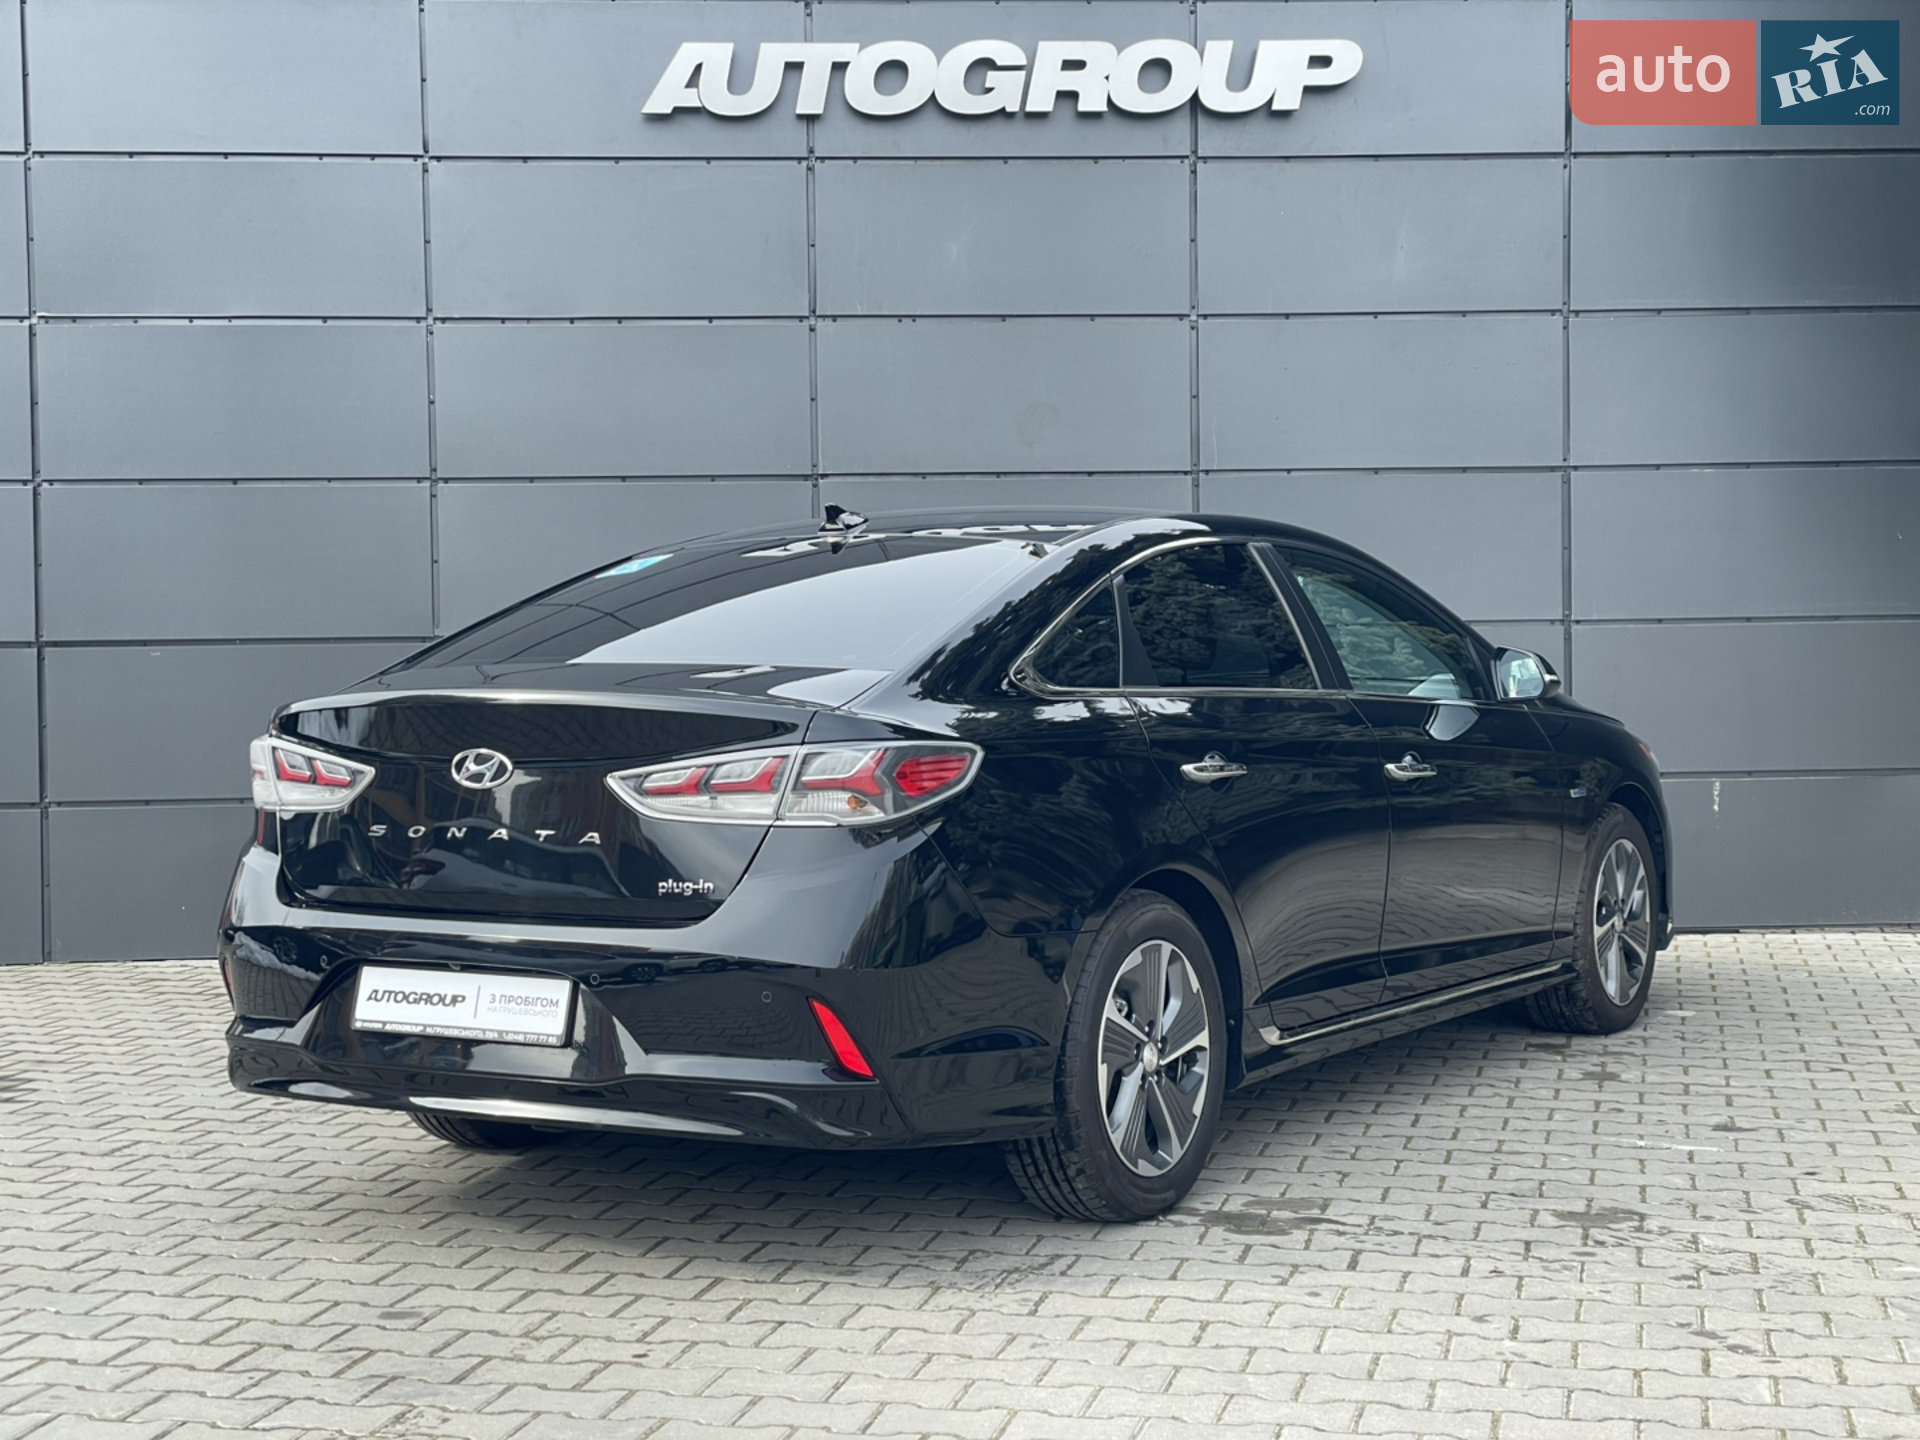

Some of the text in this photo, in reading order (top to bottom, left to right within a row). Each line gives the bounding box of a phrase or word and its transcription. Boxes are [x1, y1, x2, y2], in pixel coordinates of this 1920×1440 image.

[641, 39, 1364, 116] AUTOGROUP
[368, 824, 601, 845] SONATA
[658, 878, 714, 897] plug-in
[366, 989, 466, 1007] AUTOGROUP
[499, 994, 560, 1009] ПРОБІГОМ
[499, 1005, 559, 1018] ГРУШЕВСЬКОГО
